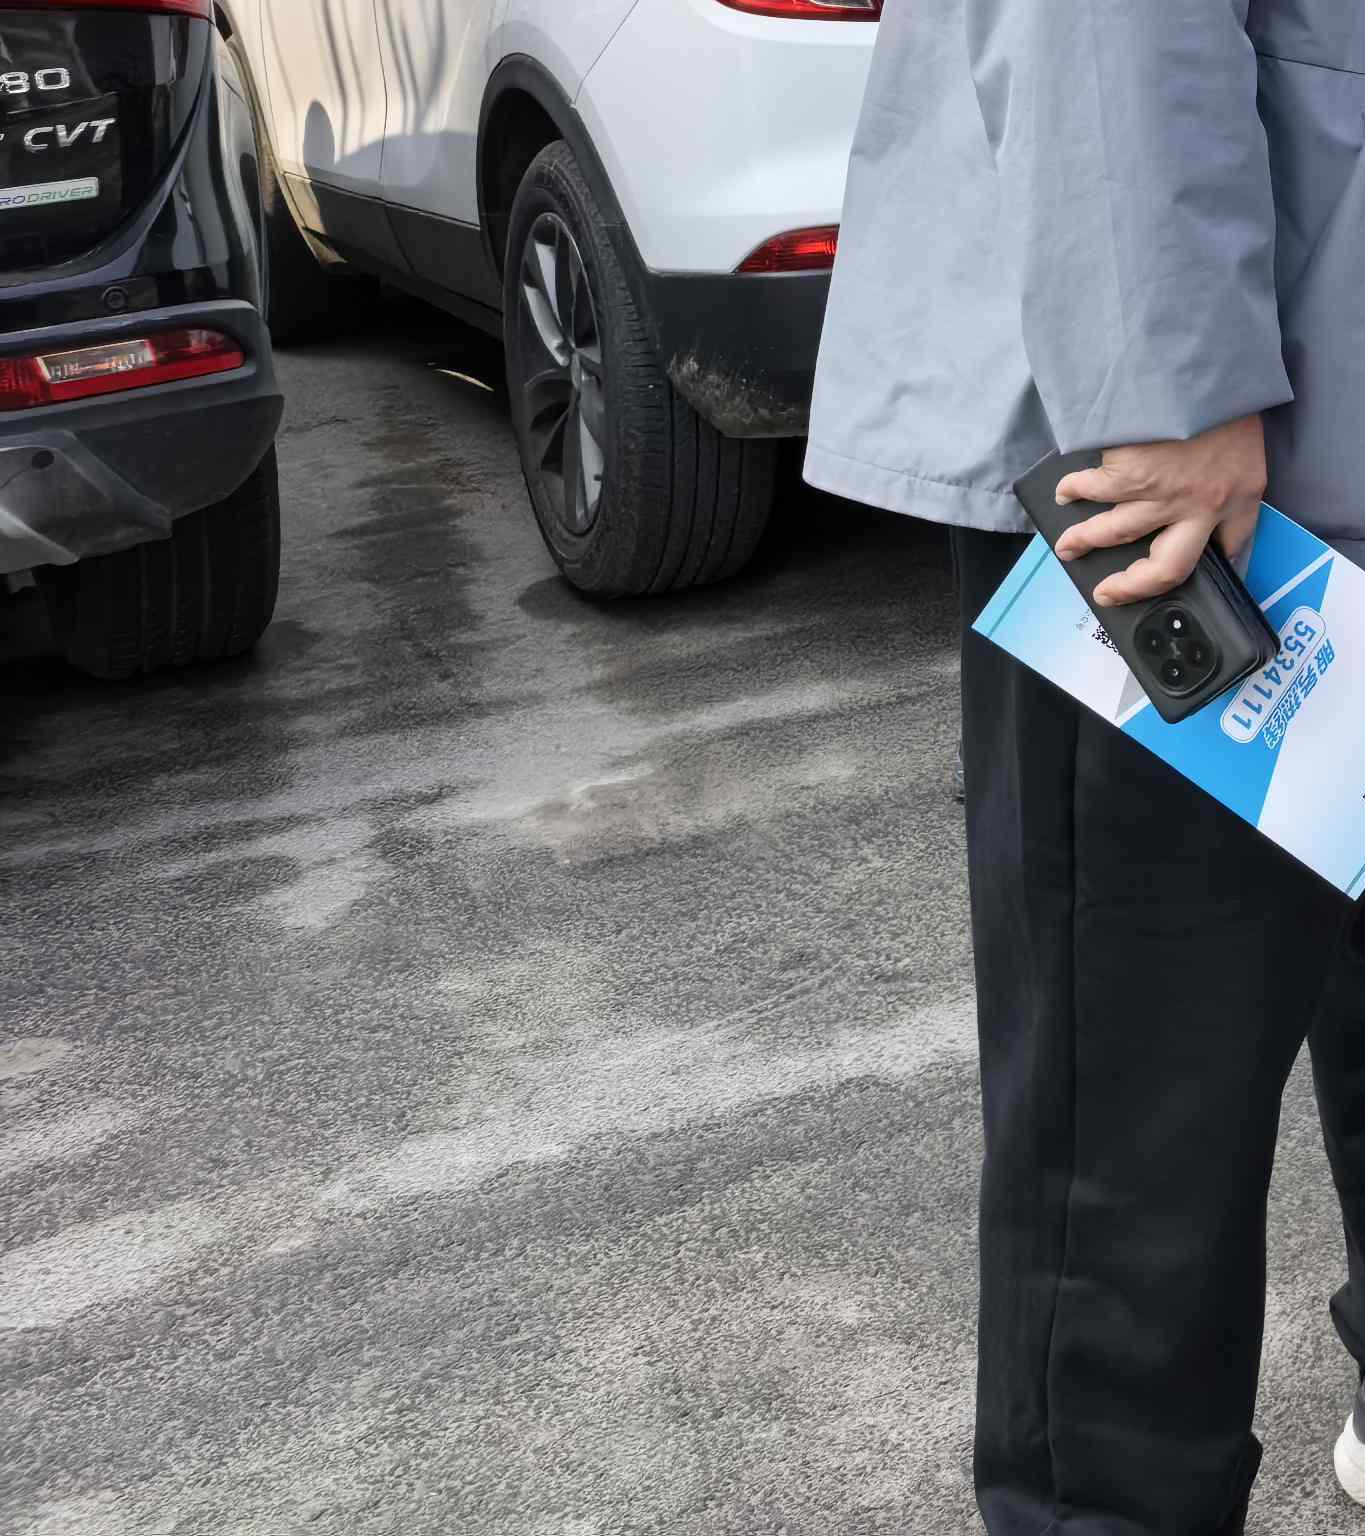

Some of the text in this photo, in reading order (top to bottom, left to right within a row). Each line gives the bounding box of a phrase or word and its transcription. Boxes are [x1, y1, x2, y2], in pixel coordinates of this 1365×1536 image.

[24, 118, 116, 152] CVT
[1232, 620, 1316, 731] 5534111
[1263, 639, 1334, 750] 服务热线
